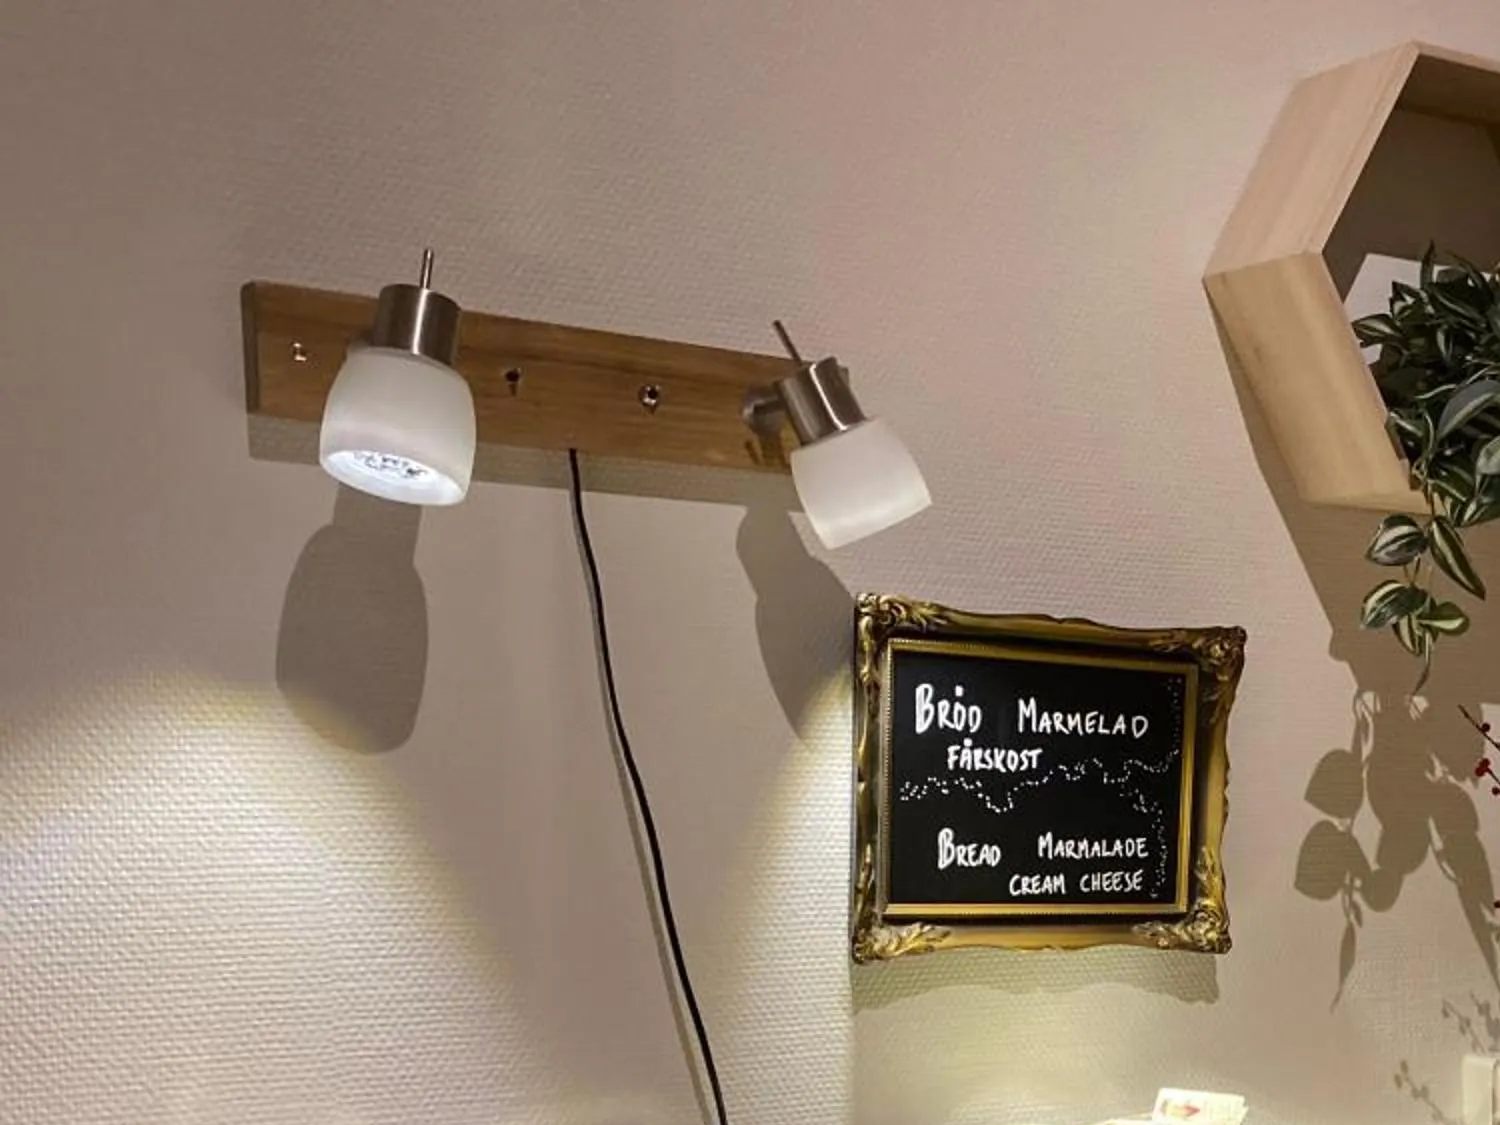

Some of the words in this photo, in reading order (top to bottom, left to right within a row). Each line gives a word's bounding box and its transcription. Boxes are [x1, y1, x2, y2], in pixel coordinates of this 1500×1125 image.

[915, 683, 982, 734] BRÖD
[1017, 697, 1149, 738] MARMELAD
[938, 828, 1001, 870] BREAD
[1037, 832, 1149, 861] MARMALADE
[1009, 873, 1066, 898] CREAM
[1079, 869, 1143, 893] CHEESE
